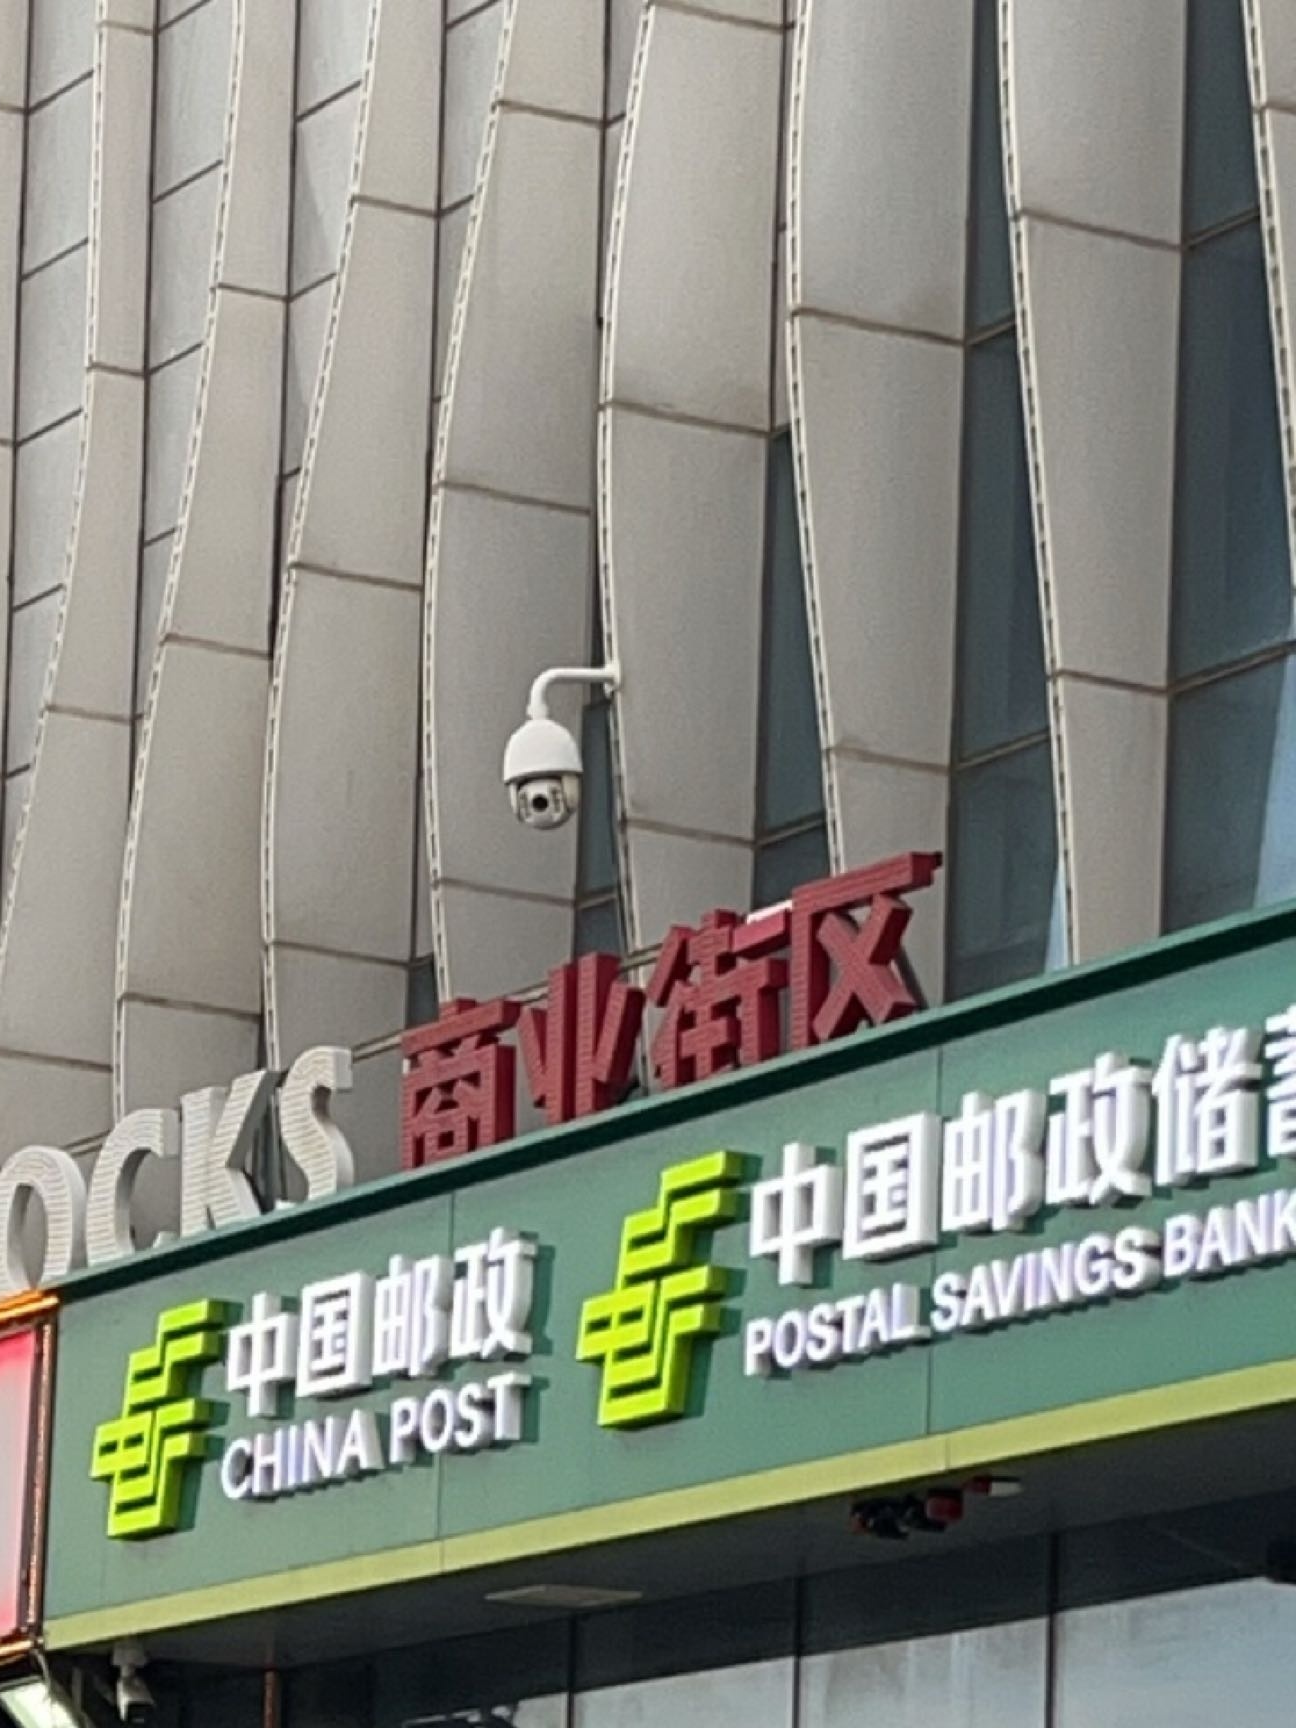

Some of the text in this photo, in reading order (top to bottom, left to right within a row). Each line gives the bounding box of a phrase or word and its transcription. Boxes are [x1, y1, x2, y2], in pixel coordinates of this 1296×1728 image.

[401, 851, 942, 1169] 商业街区
[224, 1228, 538, 1417] 中国邮政
[744, 1282, 931, 1376] POSTAL
[930, 1226, 1162, 1334] SAVINGS
[220, 1372, 532, 1502] CHINA POST
